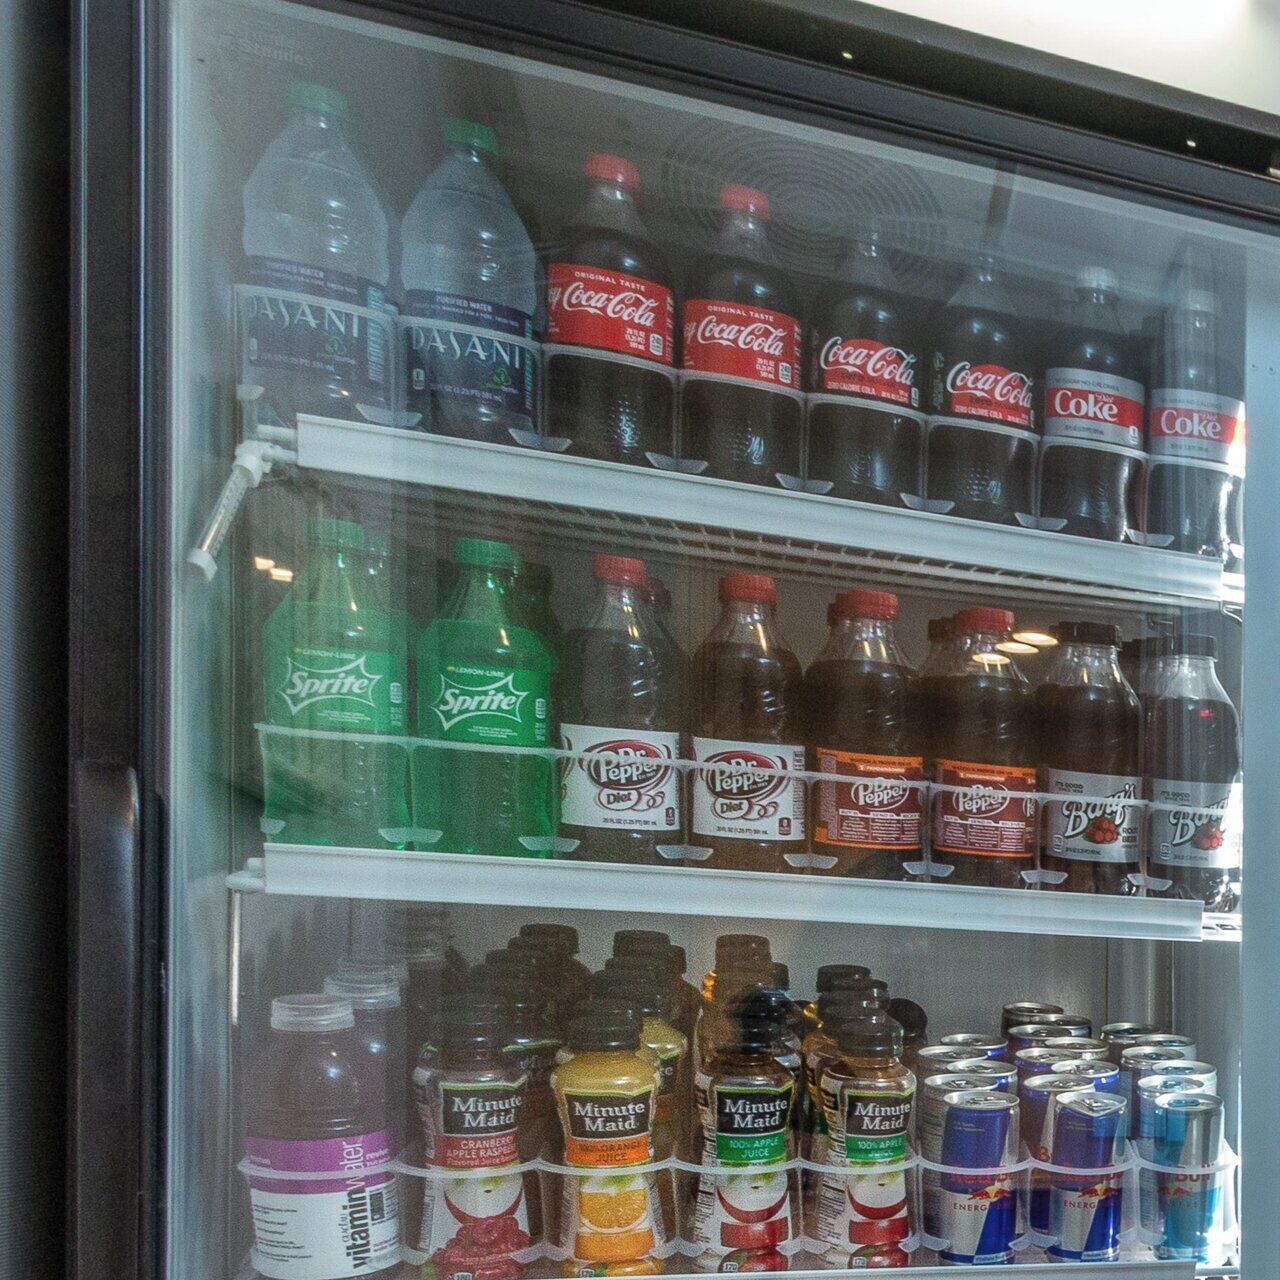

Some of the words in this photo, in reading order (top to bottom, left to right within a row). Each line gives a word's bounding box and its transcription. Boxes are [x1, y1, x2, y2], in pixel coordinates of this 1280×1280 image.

[574, 270, 616, 286] ORIGINAL
[619, 278, 647, 292] TASTE
[562, 281, 660, 328] Coca-Cola
[706, 304, 747, 317] ORIGINAL
[749, 311, 775, 323] TASTE
[696, 315, 789, 356] Coca-Cola
[413, 326, 520, 369] DASANI
[820, 336, 918, 387] Coca-Cola
[945, 361, 1034, 408] Coca-Cola
[1055, 389, 1119, 423] Coke
[1160, 409, 1222, 439] Coke
[290, 672, 371, 697] Sprite
[442, 690, 518, 715] Sprite
[605, 790, 633, 806] Diet
[719, 801, 745, 815] Diet
[452, 1095, 523, 1113] Minute
[574, 1102, 645, 1118] Minute
[724, 1098, 789, 1115] Minute
[854, 1100, 912, 1117] Minute
[463, 1109, 516, 1128] Maid
[585, 1116, 637, 1132] Maid
[732, 1114, 781, 1129] Maid
[861, 1116, 905, 1130] Maid
[752, 1137, 780, 1148] APPLE
